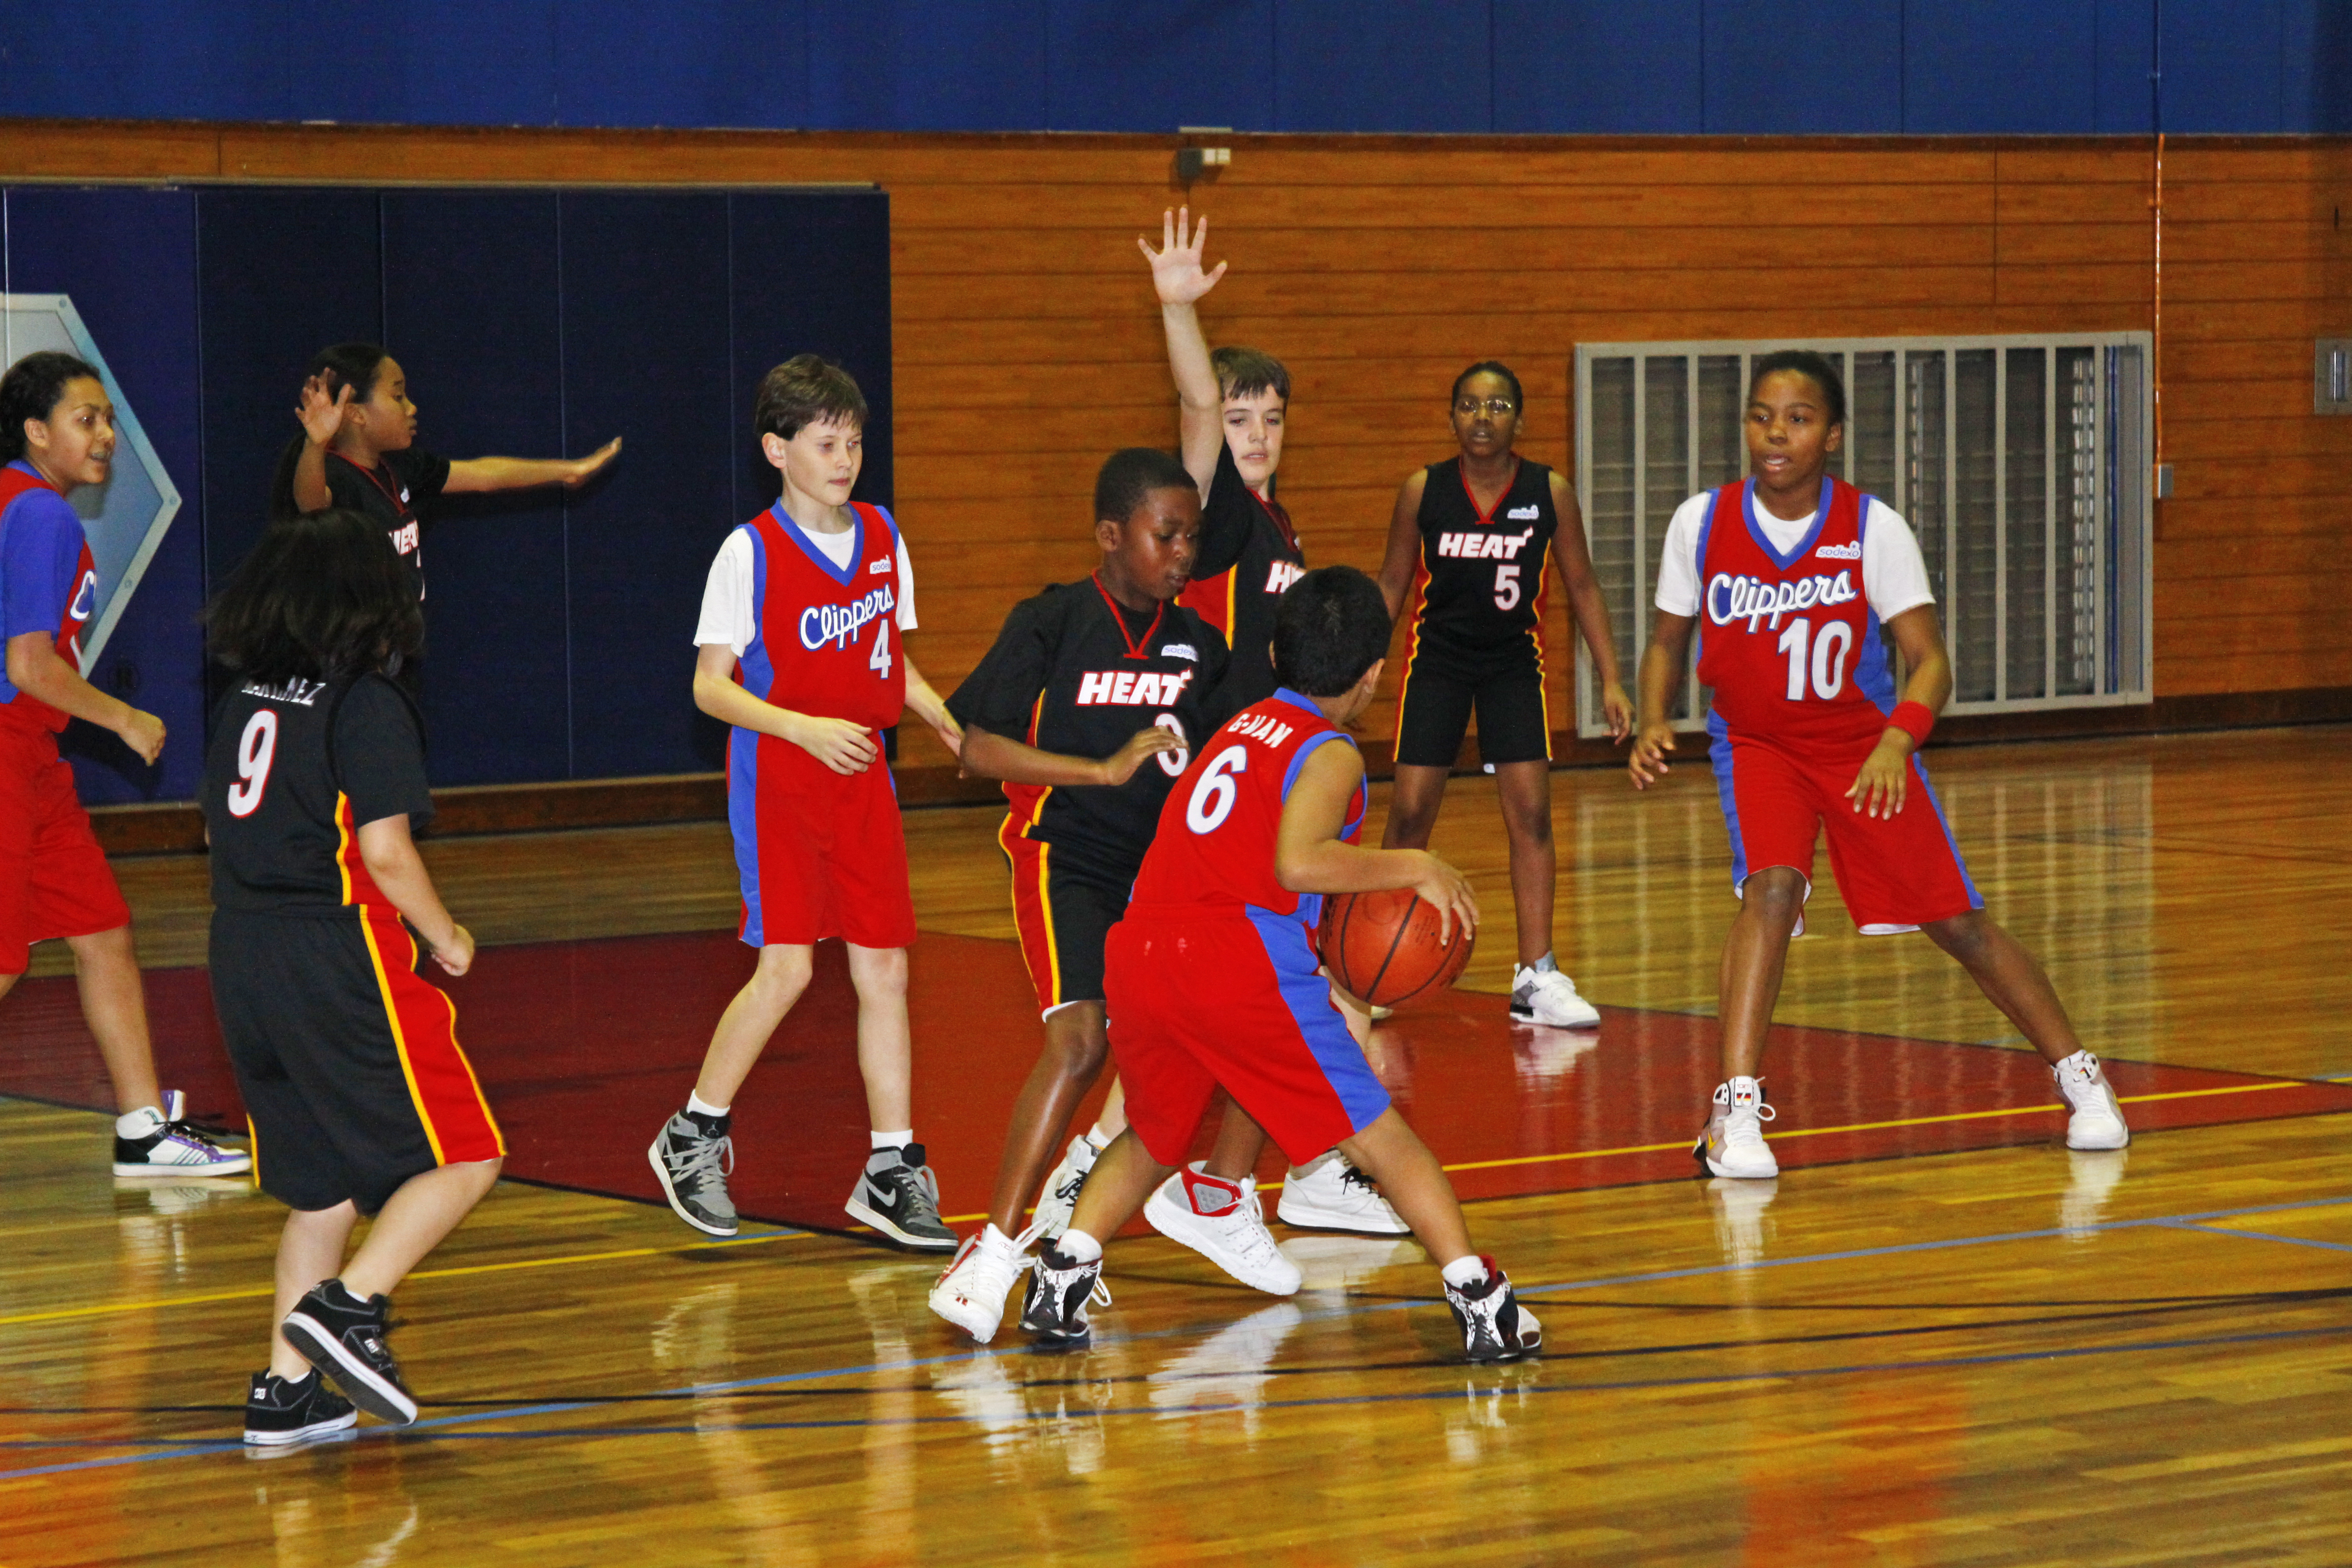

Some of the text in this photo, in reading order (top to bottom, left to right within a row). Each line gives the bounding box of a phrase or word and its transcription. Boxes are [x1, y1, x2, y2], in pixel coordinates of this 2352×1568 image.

[1438, 526, 1533, 560] HEAT
[1819, 547, 1860, 557] sodexo
[799, 583, 895, 651] Clippers
[1493, 564, 1521, 611] 5
[1706, 570, 1859, 634] Clippers
[869, 618, 892, 679] 4
[1777, 617, 1853, 701] 10
[1076, 666, 1194, 707] HEAT
[228, 708, 279, 819] 9
[1185, 744, 1247, 836] 6
